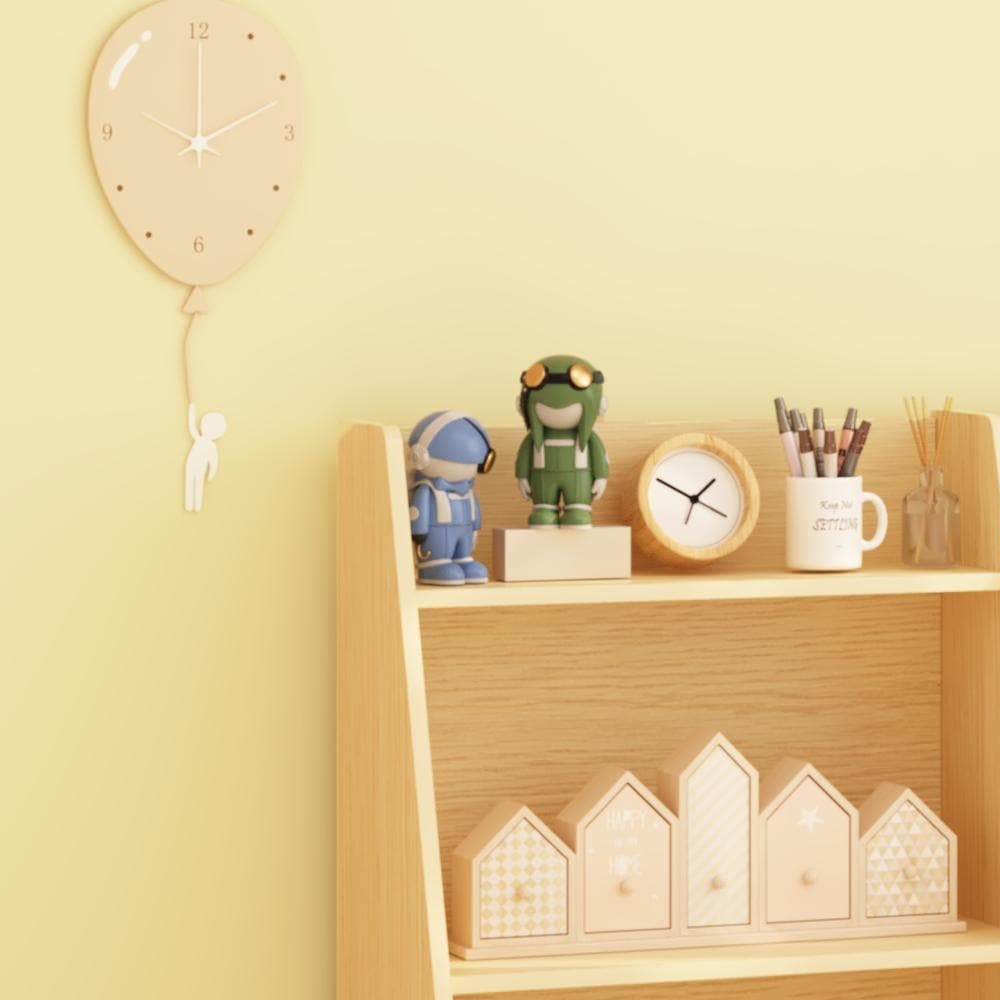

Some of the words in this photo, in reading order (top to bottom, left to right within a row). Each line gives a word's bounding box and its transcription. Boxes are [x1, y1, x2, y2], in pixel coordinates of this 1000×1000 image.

[188, 22, 209, 40] 12
[102, 123, 113, 141] 9
[283, 124, 295, 142] 3
[193, 236, 204, 253] 6
